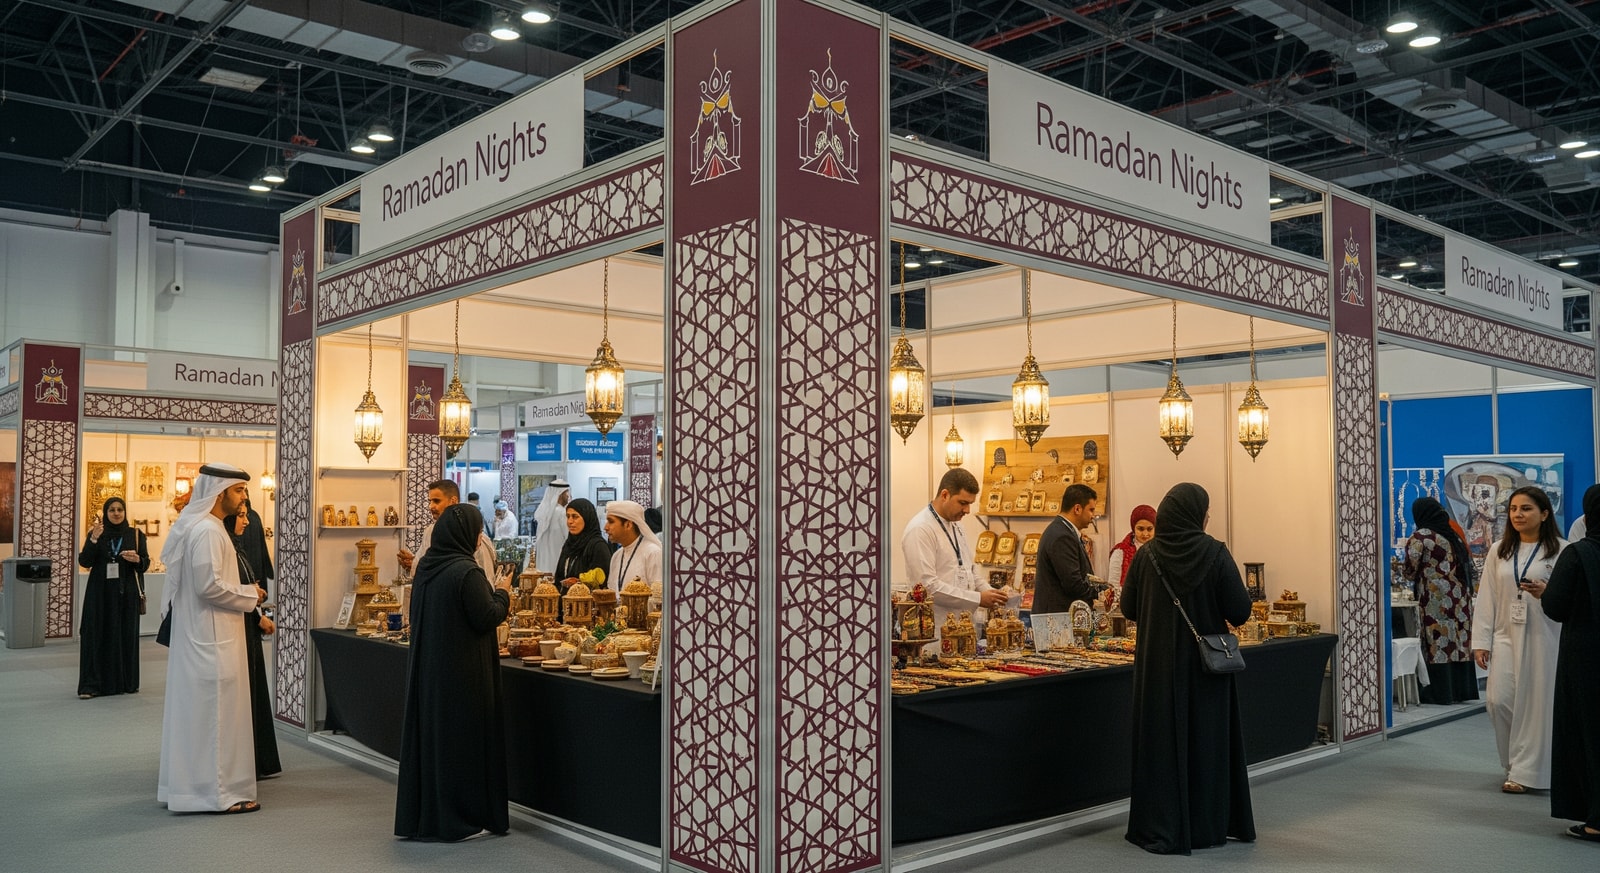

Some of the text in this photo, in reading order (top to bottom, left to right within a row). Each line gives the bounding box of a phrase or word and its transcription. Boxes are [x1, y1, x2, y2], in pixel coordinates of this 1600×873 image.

[382, 120, 547, 222] Ramadan Nights
[1036, 101, 1243, 210] Ramadan Nights
[1461, 255, 1550, 312] Ramadan Nights
[175, 363, 264, 387] Ramadan
[532, 401, 585, 419] Ramadan Nig
